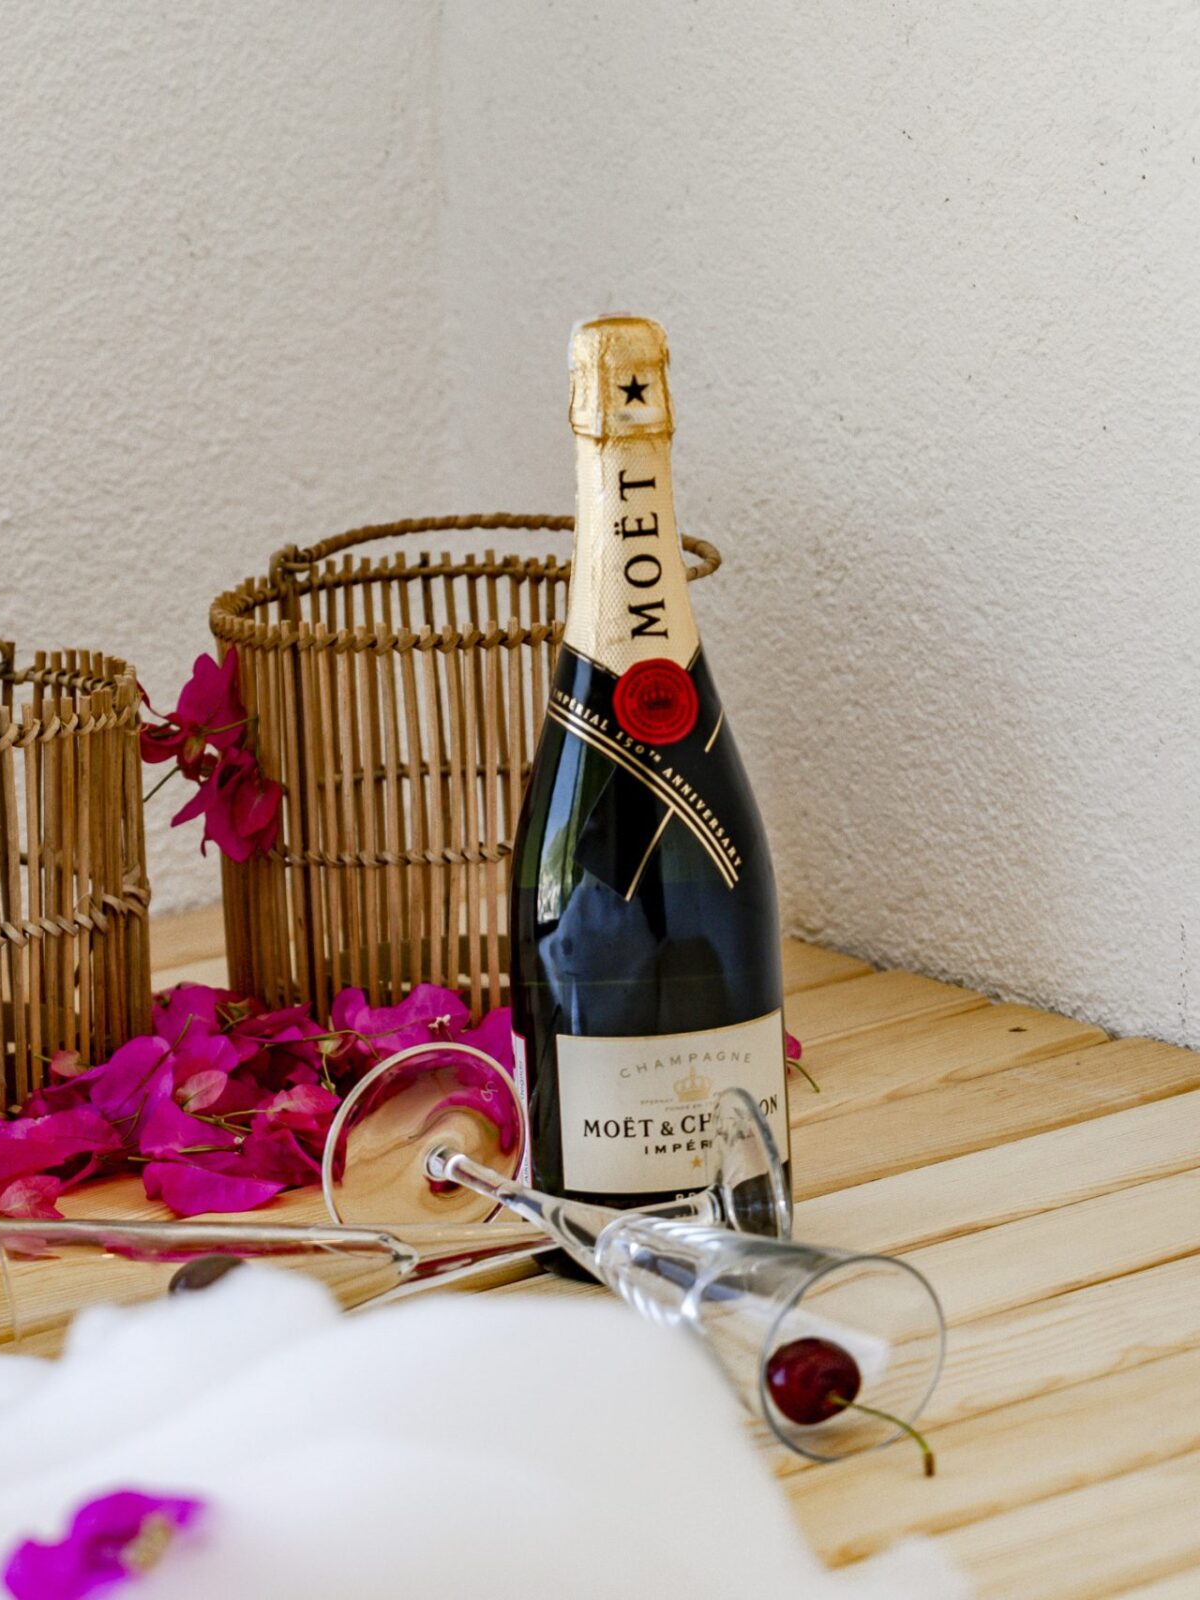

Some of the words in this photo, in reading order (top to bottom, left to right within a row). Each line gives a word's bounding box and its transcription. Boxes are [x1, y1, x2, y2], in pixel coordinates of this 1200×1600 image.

[614, 469, 669, 639] MOËT
[663, 767, 742, 867] ANNIVERSARY
[619, 1052, 752, 1079] CHAMPAGNE
[583, 1116, 653, 1139] MOËT
[660, 1120, 675, 1137] &
